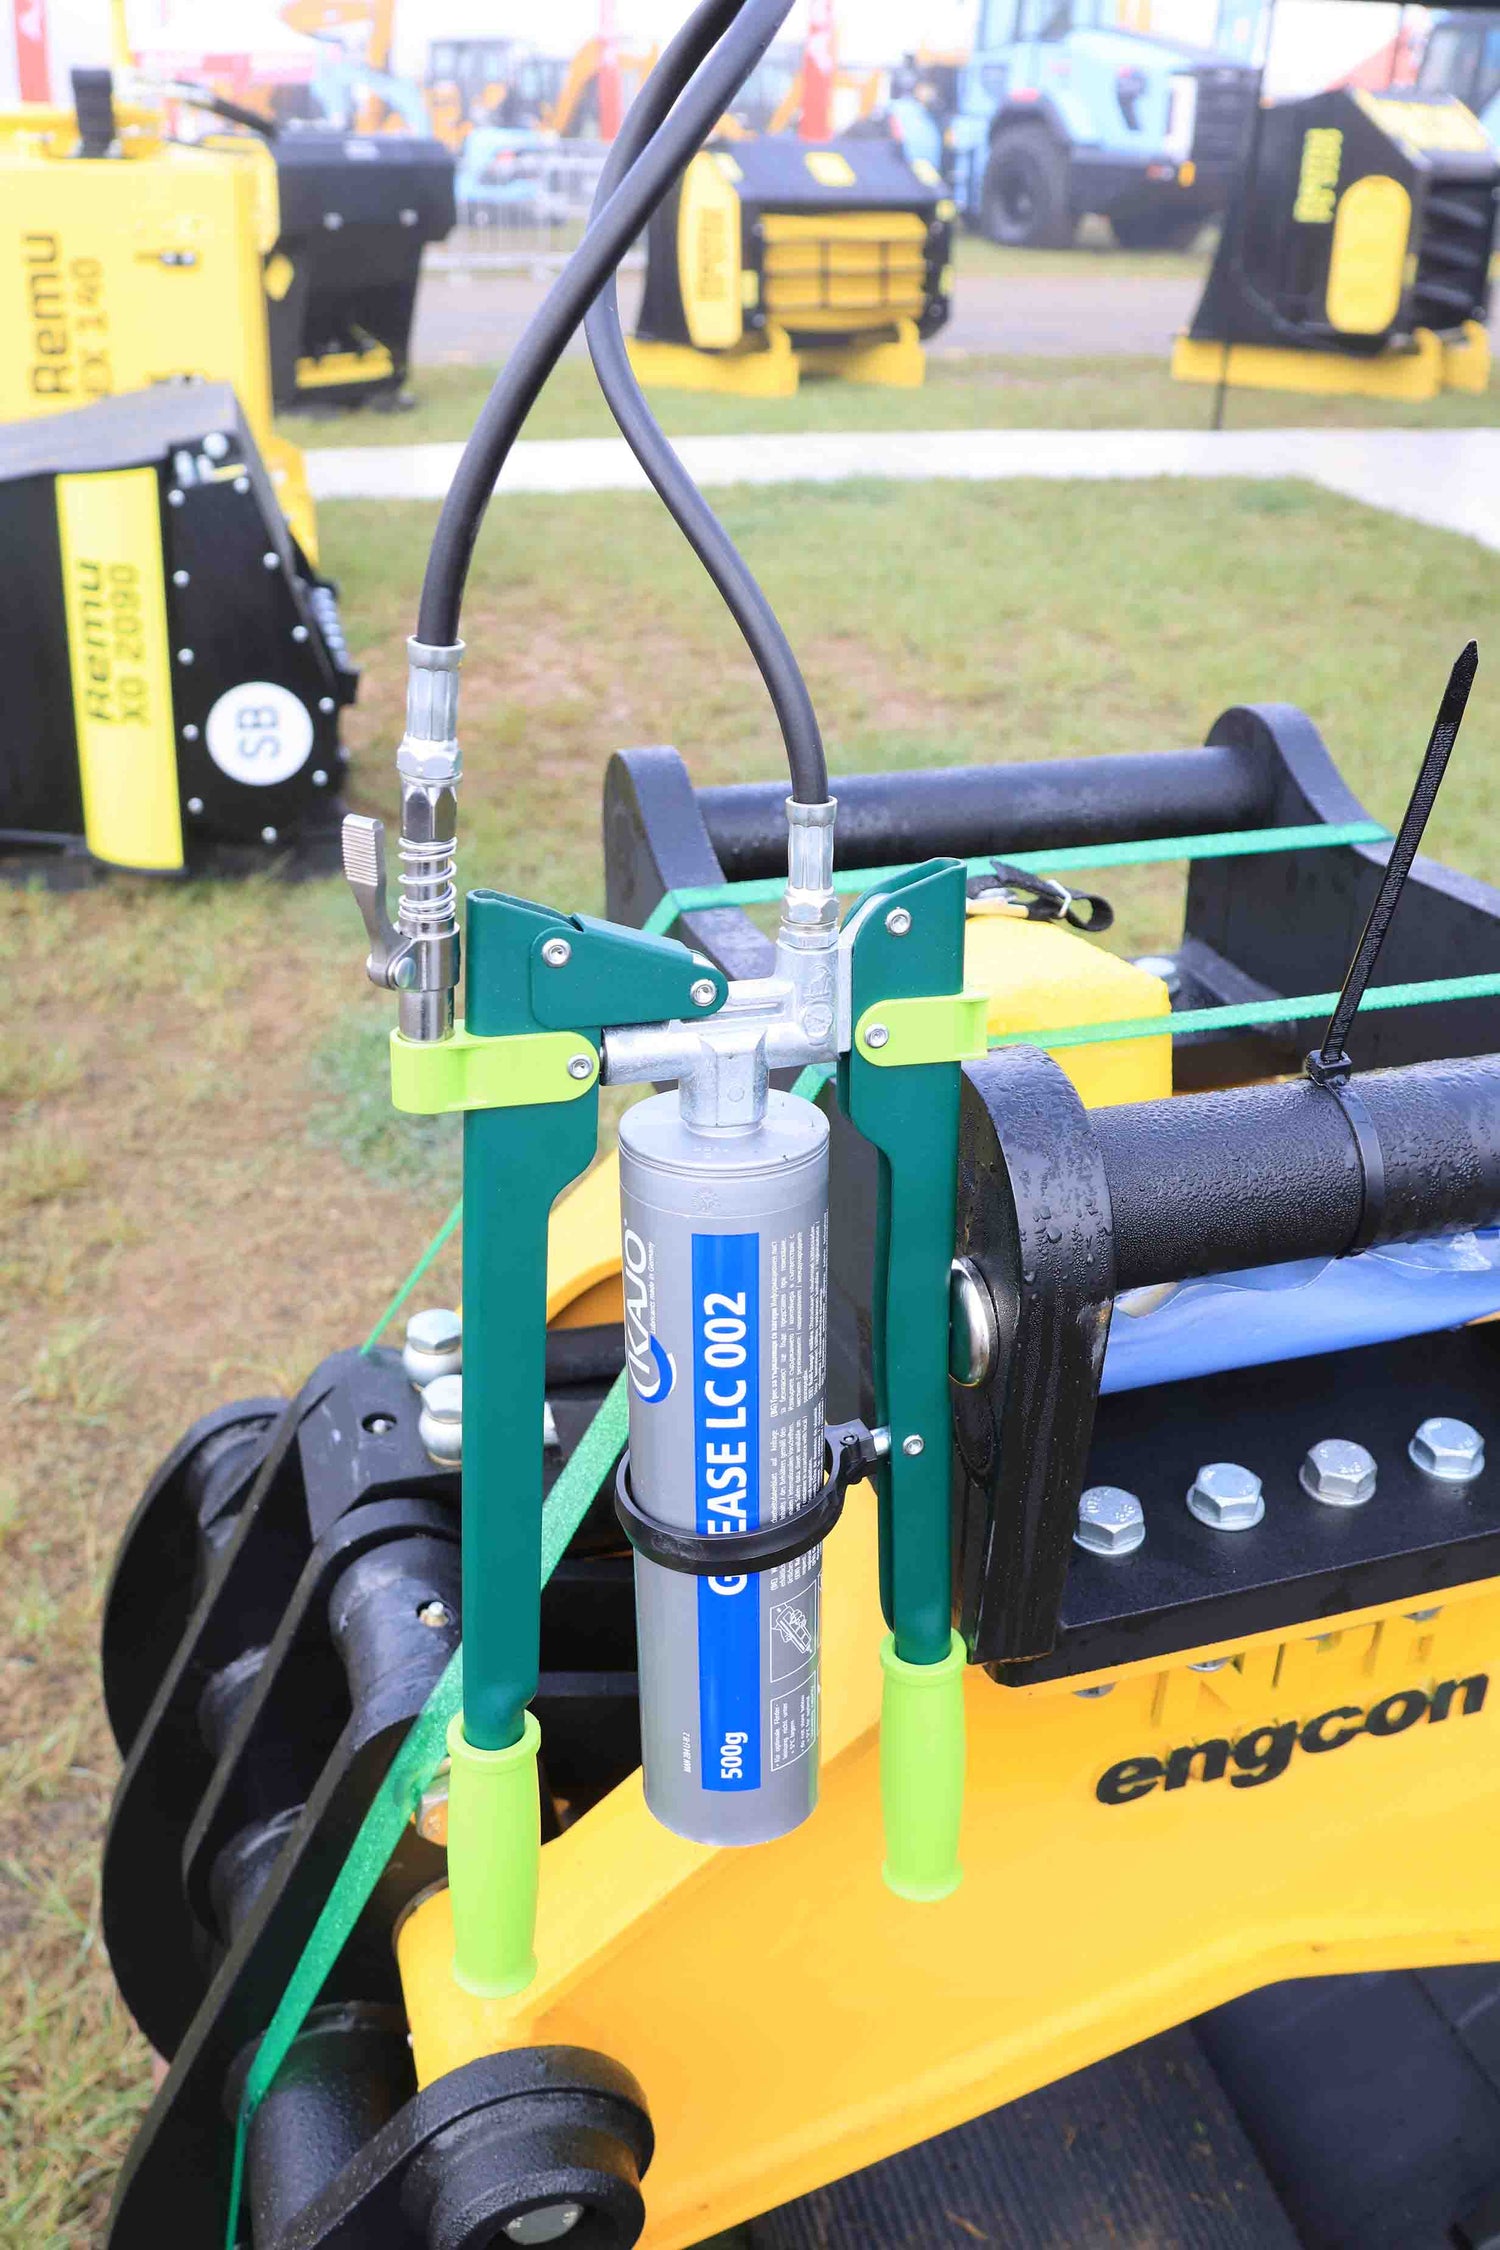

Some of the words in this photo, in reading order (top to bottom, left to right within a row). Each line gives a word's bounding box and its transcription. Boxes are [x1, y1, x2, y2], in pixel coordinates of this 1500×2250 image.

[25, 234, 72, 395] Remu
[78, 560, 110, 721] Remu
[238, 705, 281, 760] SB
[647, 1241, 656, 1272] Germany
[624, 1228, 650, 1375] KAJO
[648, 1281, 656, 1300] made
[648, 1301, 657, 1335] Lubricants
[703, 1291, 747, 1369] 002
[704, 1379, 747, 1428] LC
[706, 1441, 747, 1596] GEASE
[720, 1731, 749, 1779] 500g
[1096, 1673, 1489, 1805] engcon
